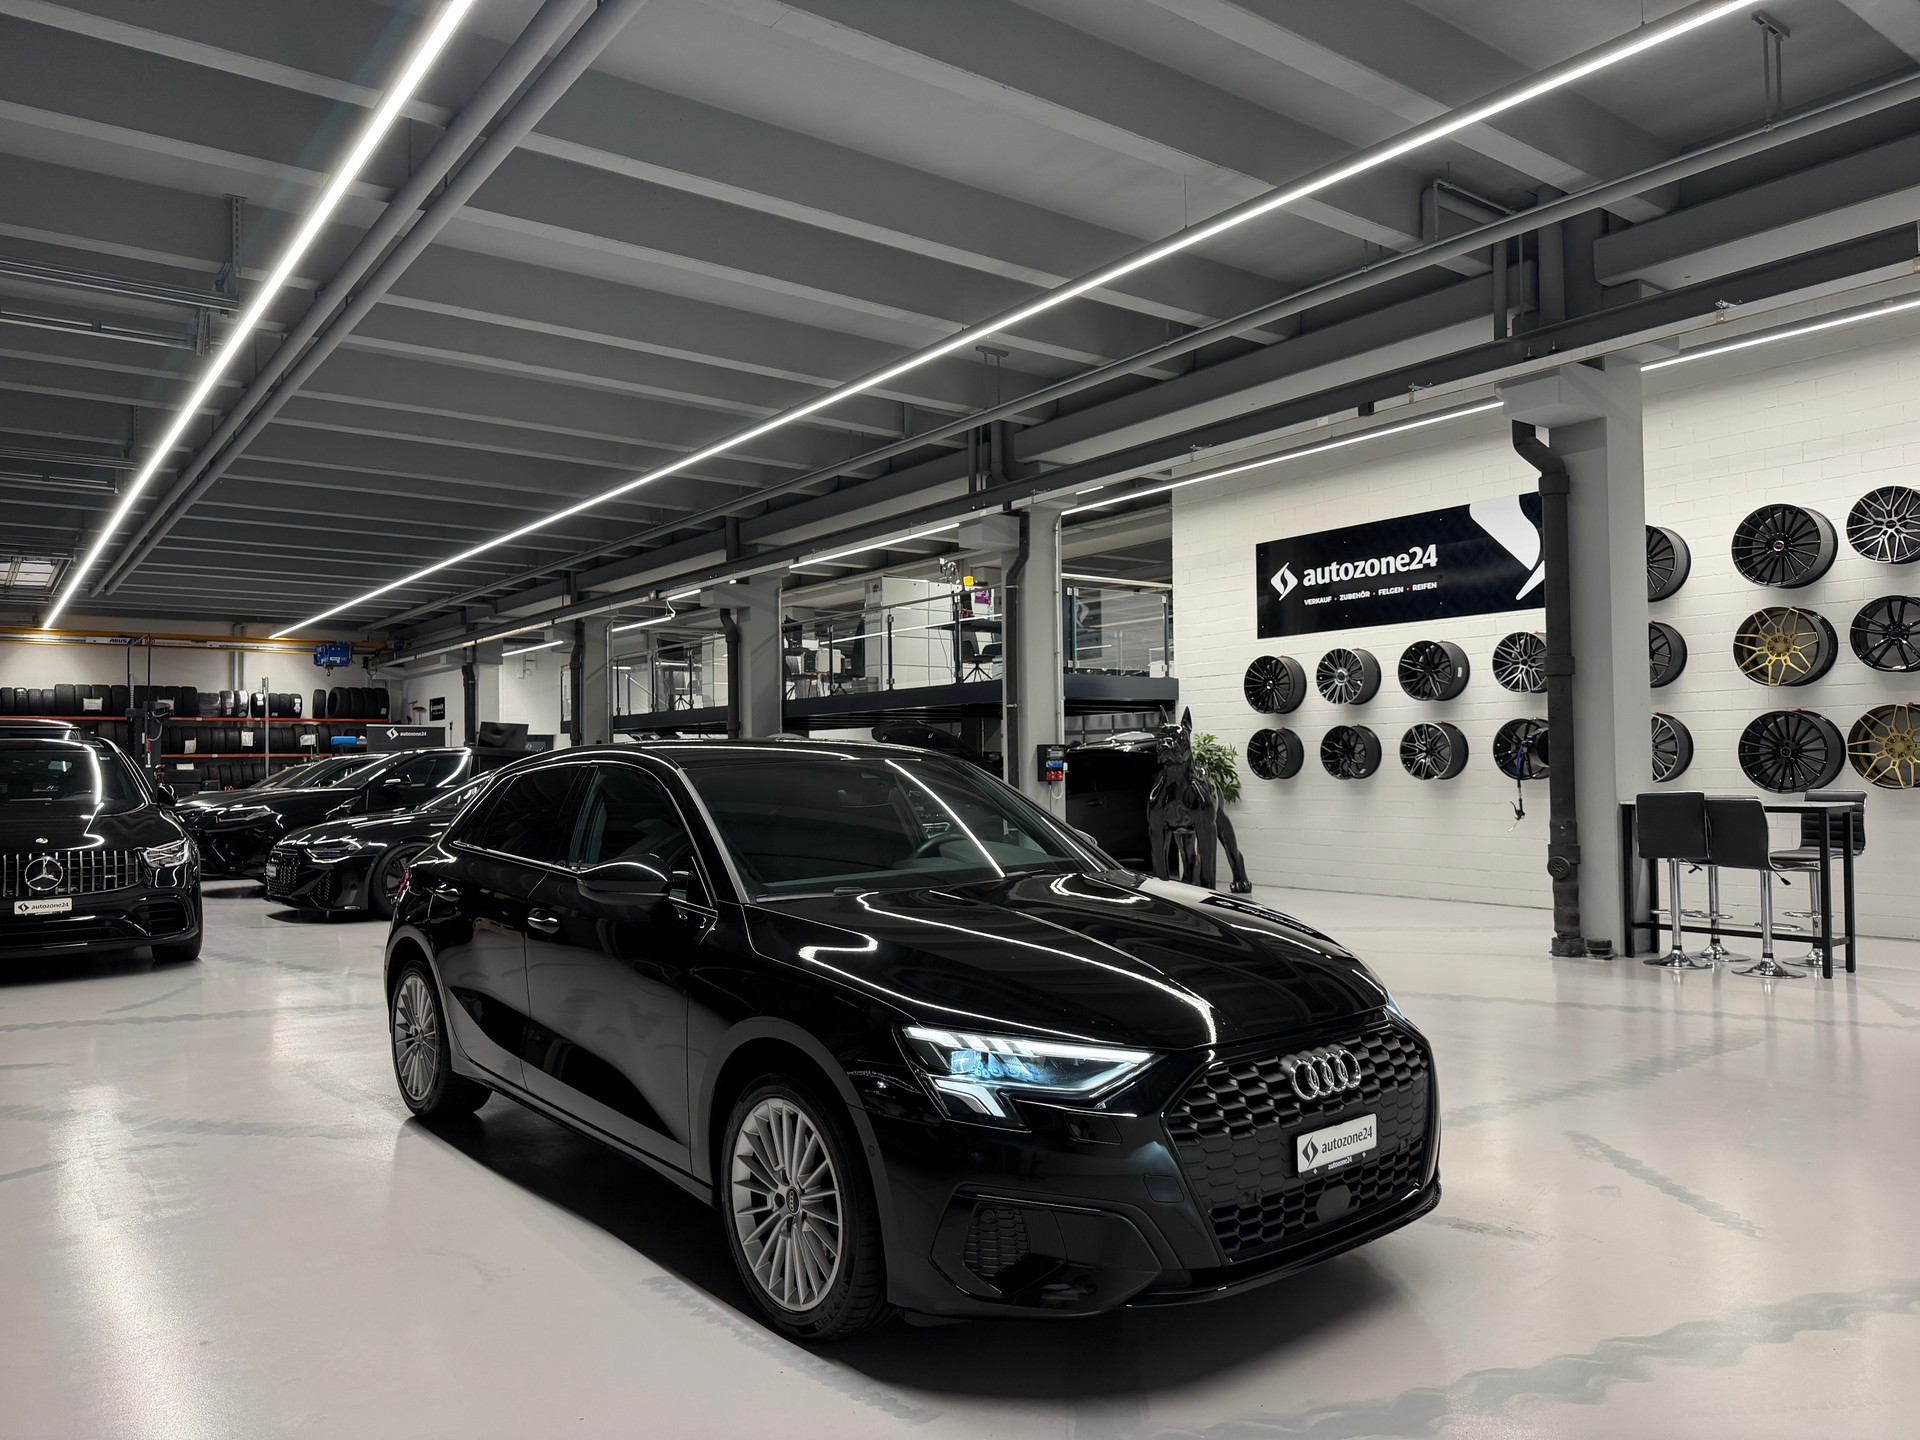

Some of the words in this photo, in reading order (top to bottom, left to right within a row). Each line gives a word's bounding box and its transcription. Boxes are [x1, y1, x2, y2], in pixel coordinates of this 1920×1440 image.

[1303, 544, 1438, 587] autozone24
[1303, 596, 1332, 606] VERKAUF
[1339, 590, 1371, 601] ZUBEHÖR
[1378, 586, 1404, 596] FELGEN
[1412, 581, 1438, 591] REIFEN
[31, 902, 69, 910] autozone24
[1321, 1126, 1373, 1154] autozone24
[1327, 1156, 1353, 1170] autozone24
